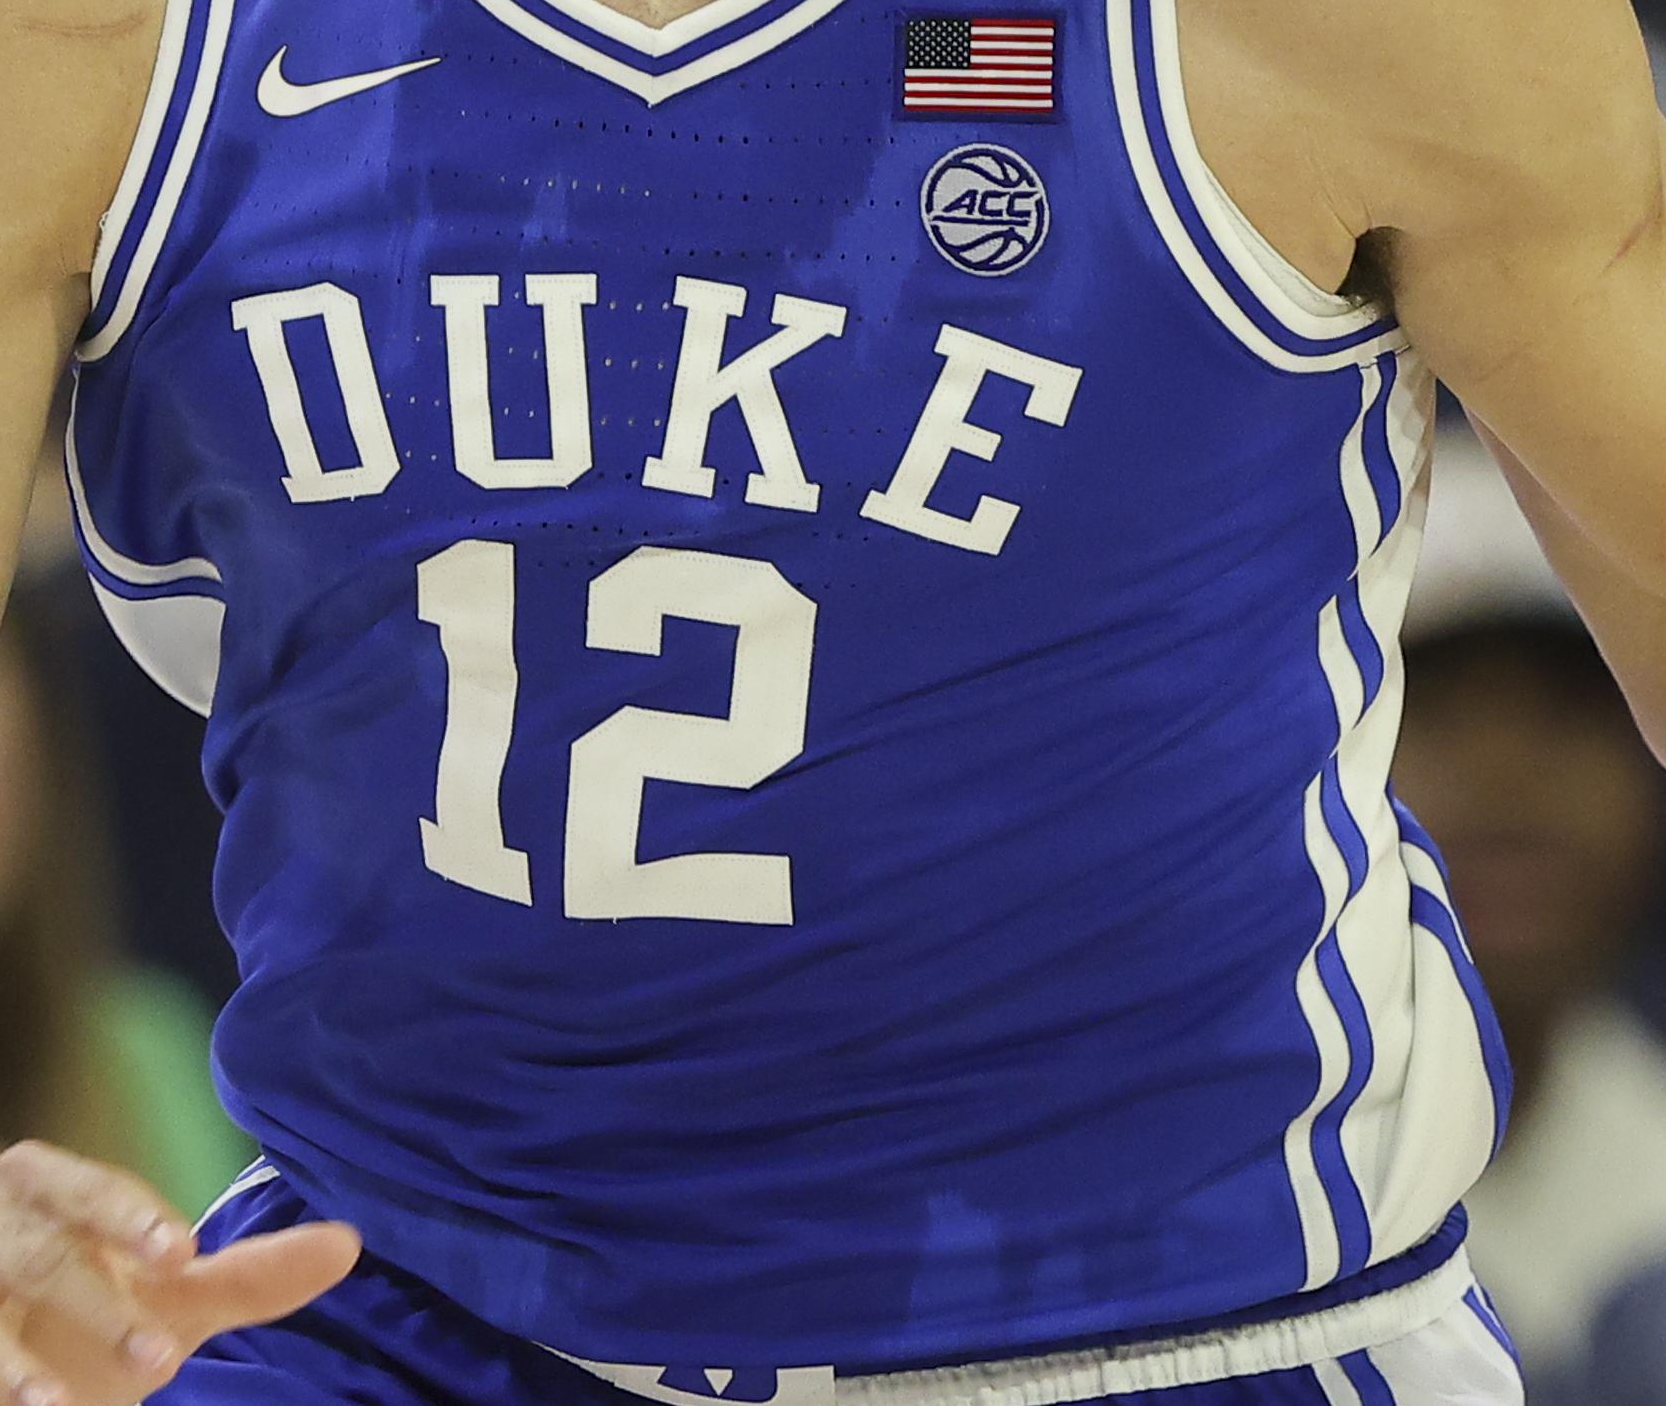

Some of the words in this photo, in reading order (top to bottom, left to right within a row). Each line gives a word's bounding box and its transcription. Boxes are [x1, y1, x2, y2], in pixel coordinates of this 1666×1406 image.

[943, 188, 1040, 218] ACC
[231, 272, 1083, 556] DUKE
[416, 538, 818, 926] 12
